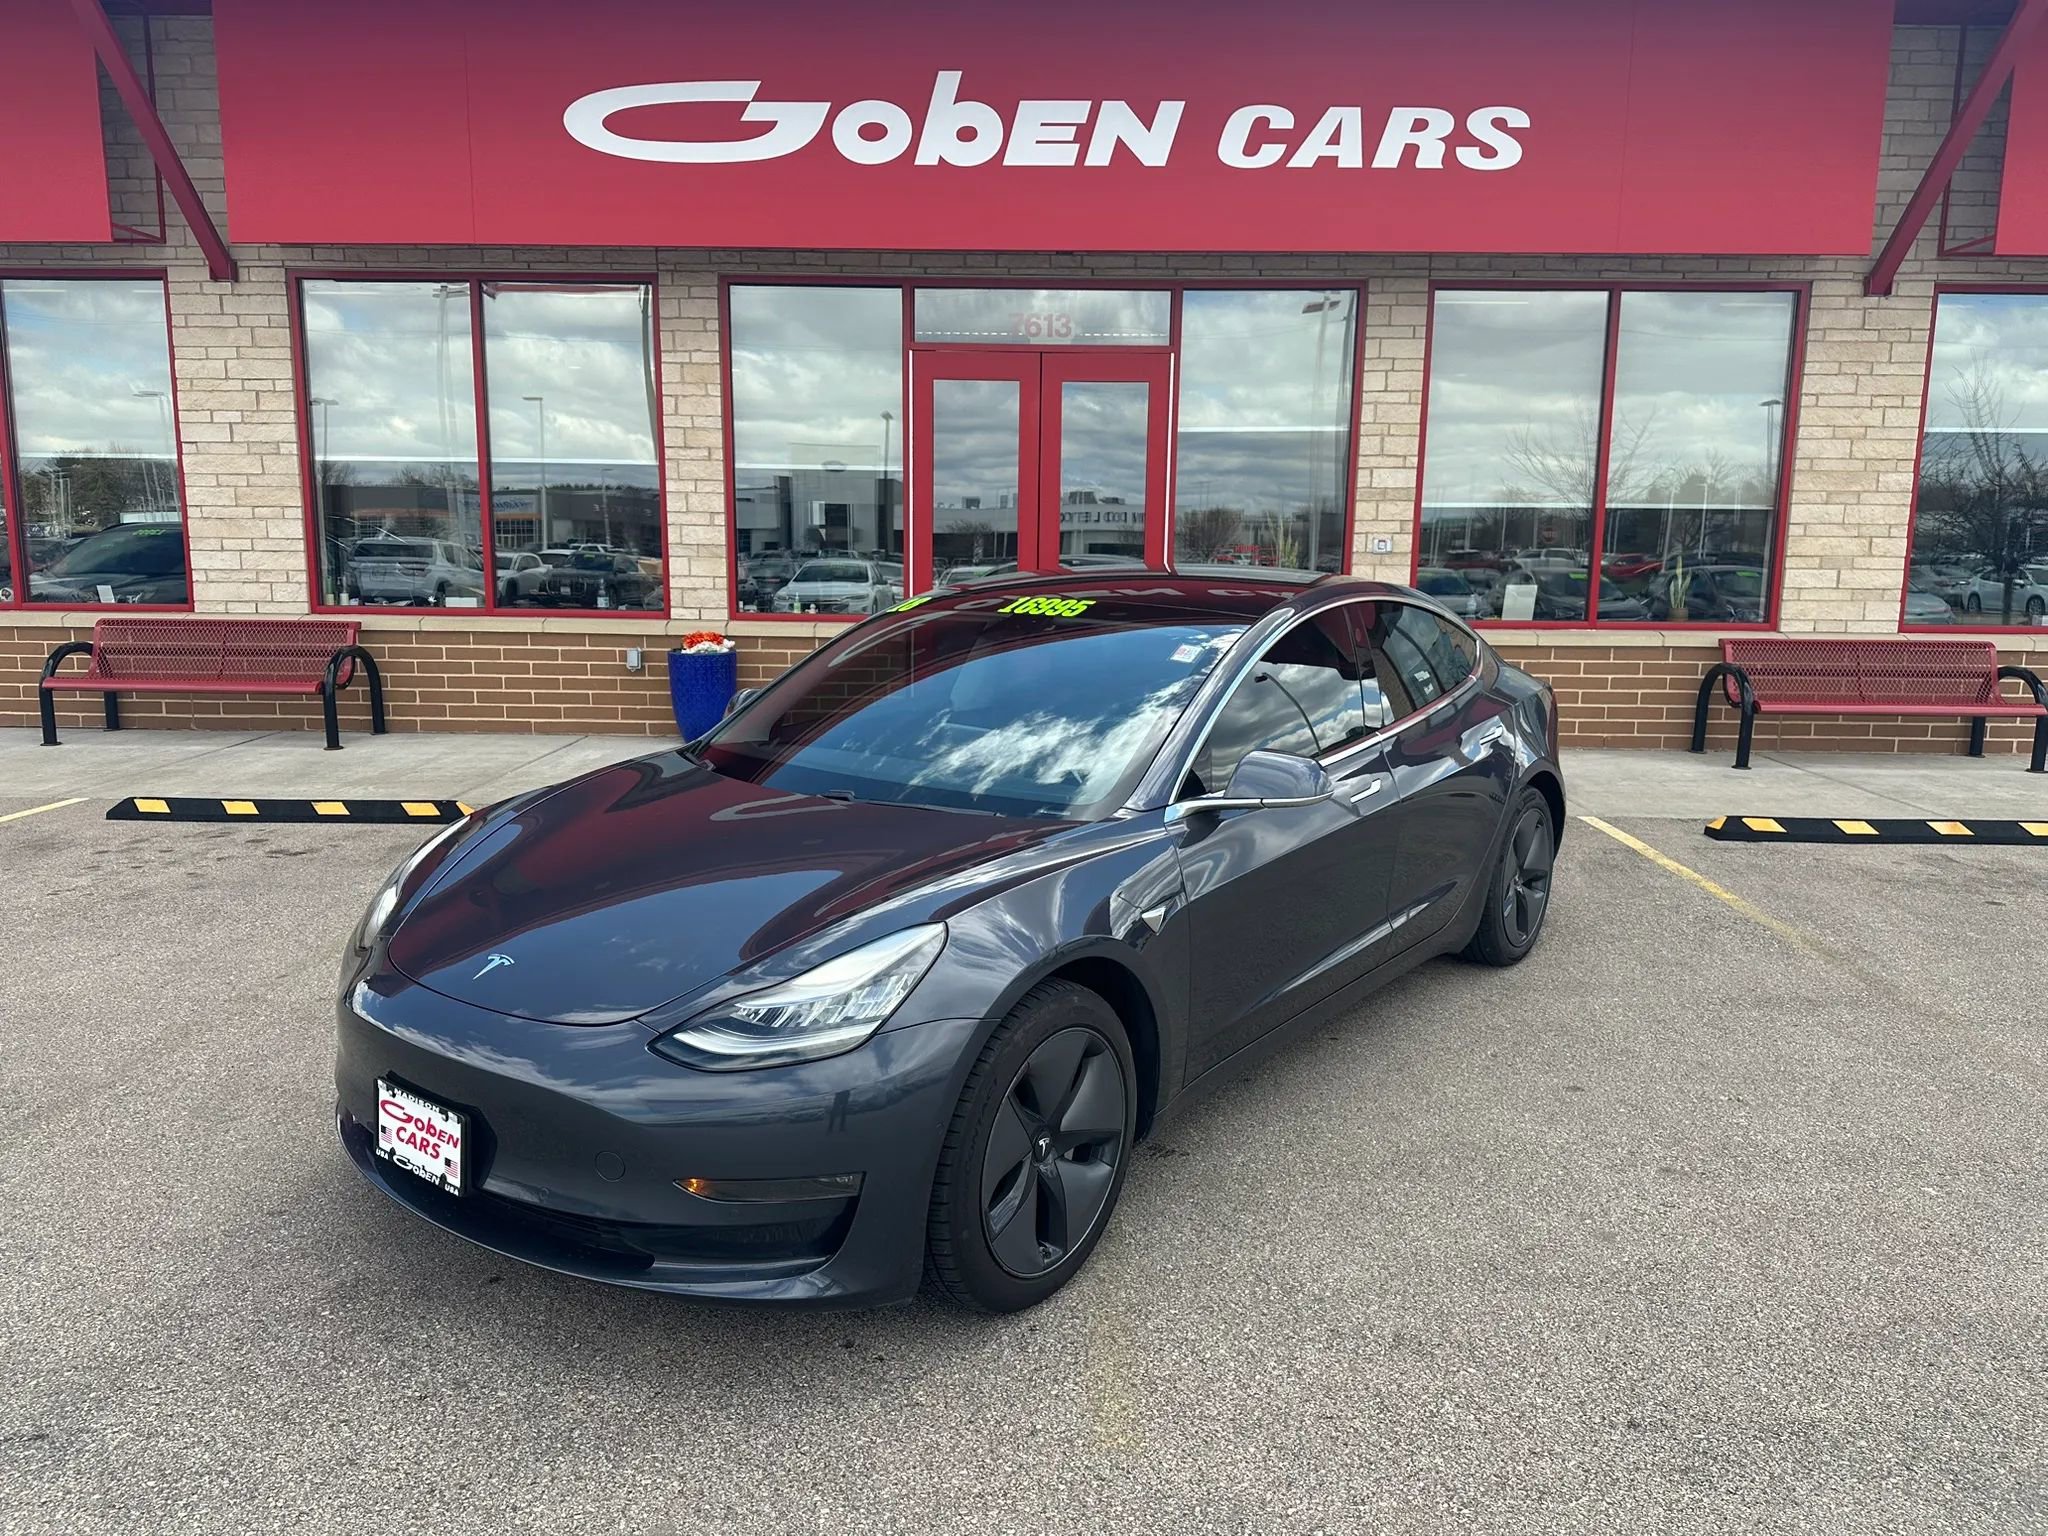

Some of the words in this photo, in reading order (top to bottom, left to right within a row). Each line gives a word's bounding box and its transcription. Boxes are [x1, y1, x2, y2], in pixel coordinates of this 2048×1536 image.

[1216, 104, 1532, 172] CARS
[1008, 312, 1073, 338] 7613
[997, 596, 1097, 617] 16995
[393, 1087, 440, 1113] MADISON
[396, 1126, 442, 1160] CARS
[376, 1148, 389, 1160] USA
[444, 1183, 459, 1196] USA
